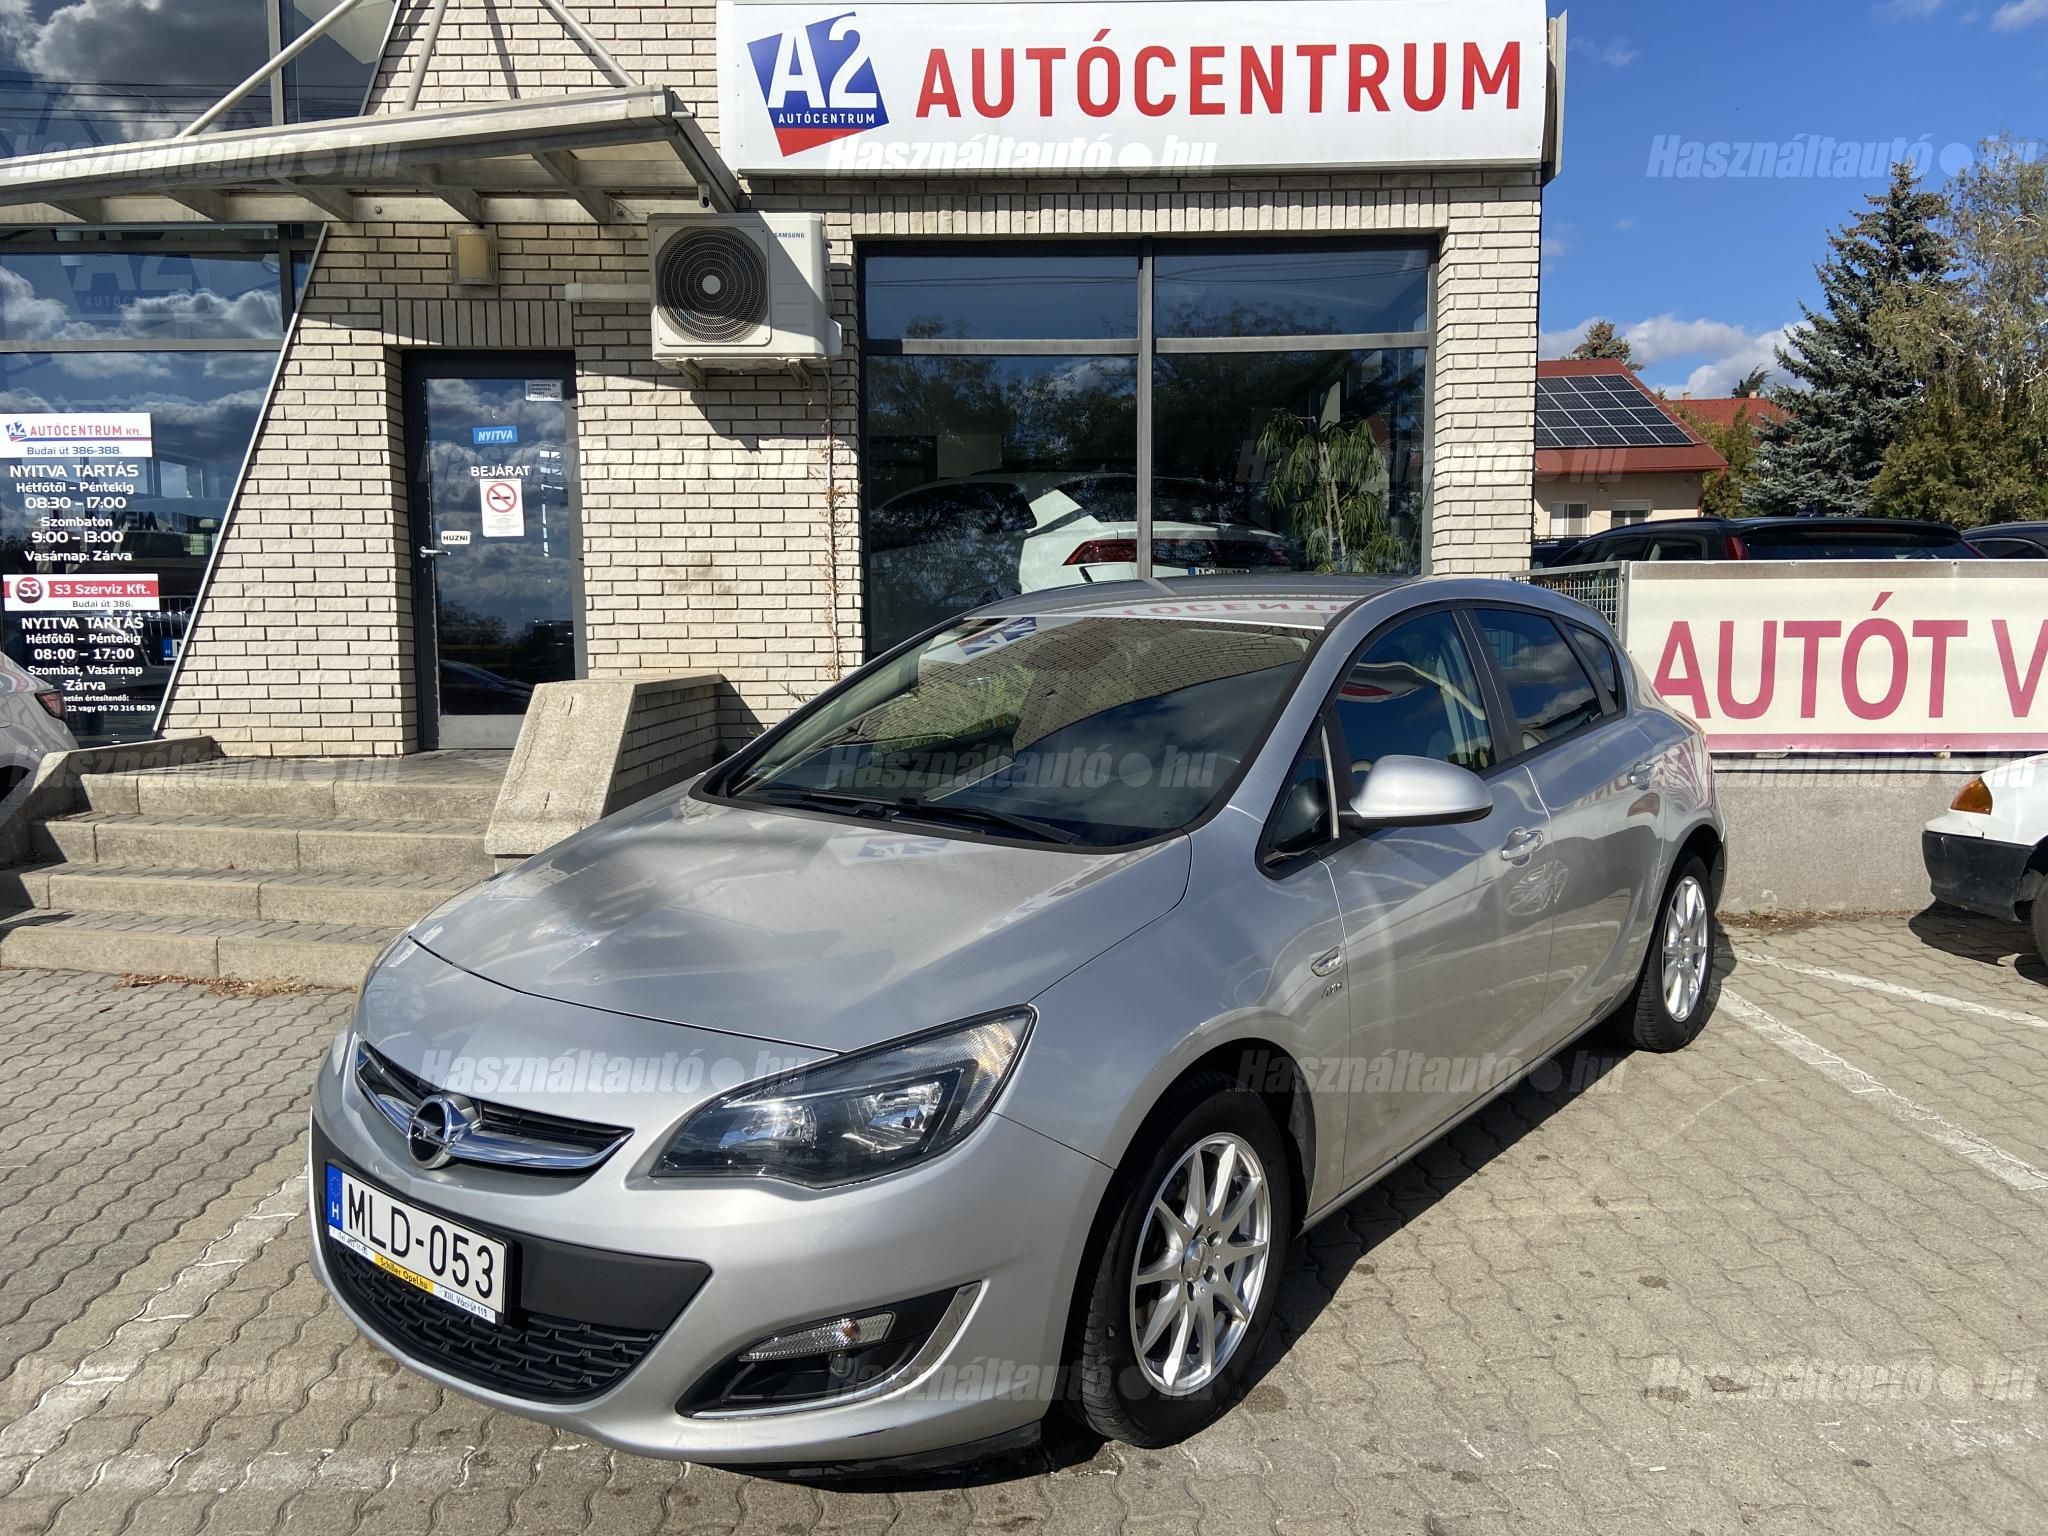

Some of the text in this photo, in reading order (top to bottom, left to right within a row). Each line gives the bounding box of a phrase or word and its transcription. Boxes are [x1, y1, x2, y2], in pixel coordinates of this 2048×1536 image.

[767, 16, 878, 108] A2
[916, 28, 1521, 119] AUTÓCENTRUM
[778, 111, 875, 124] AUTÓCENTRUM
[30, 423, 122, 436] AUTÓCENTRUM
[478, 430, 513, 442] NYITVA
[27, 446, 56, 455] Budai
[59, 446, 69, 455] út
[10, 460, 139, 478] NYITVA TARTÁS
[471, 464, 530, 477] BEJÁRAT
[16, 481, 66, 493] Hétfőtől
[80, 482, 134, 495] Péntekig
[25, 496, 71, 509] 08:30
[87, 496, 127, 509] 17:00
[41, 516, 113, 527] Szombaton
[32, 531, 68, 543] 9:00
[84, 531, 124, 543] 13:00
[24, 550, 132, 564] Vasárnap: Zárva
[19, 581, 41, 597] S3
[54, 584, 151, 595] S3 Szerviz Kft.
[72, 600, 98, 608] Budai
[101, 600, 110, 608] út
[21, 617, 79, 630] NYITVA
[26, 633, 74, 644] Hétfőtől
[89, 634, 141, 646] Péntekig
[34, 648, 75, 660] 08:00
[94, 648, 134, 660] 17:00
[1652, 592, 1968, 720] AUTÓT
[28, 664, 143, 677] Szombat, Vasárnap
[65, 679, 106, 691] Zárva
[64, 694, 83, 702] setén
[97, 704, 107, 712] 06
[109, 704, 119, 712] 70
[120, 704, 135, 712] 316
[136, 704, 156, 712] 8639
[332, 1202, 339, 1220] H
[348, 1183, 494, 1299] MLD-053
